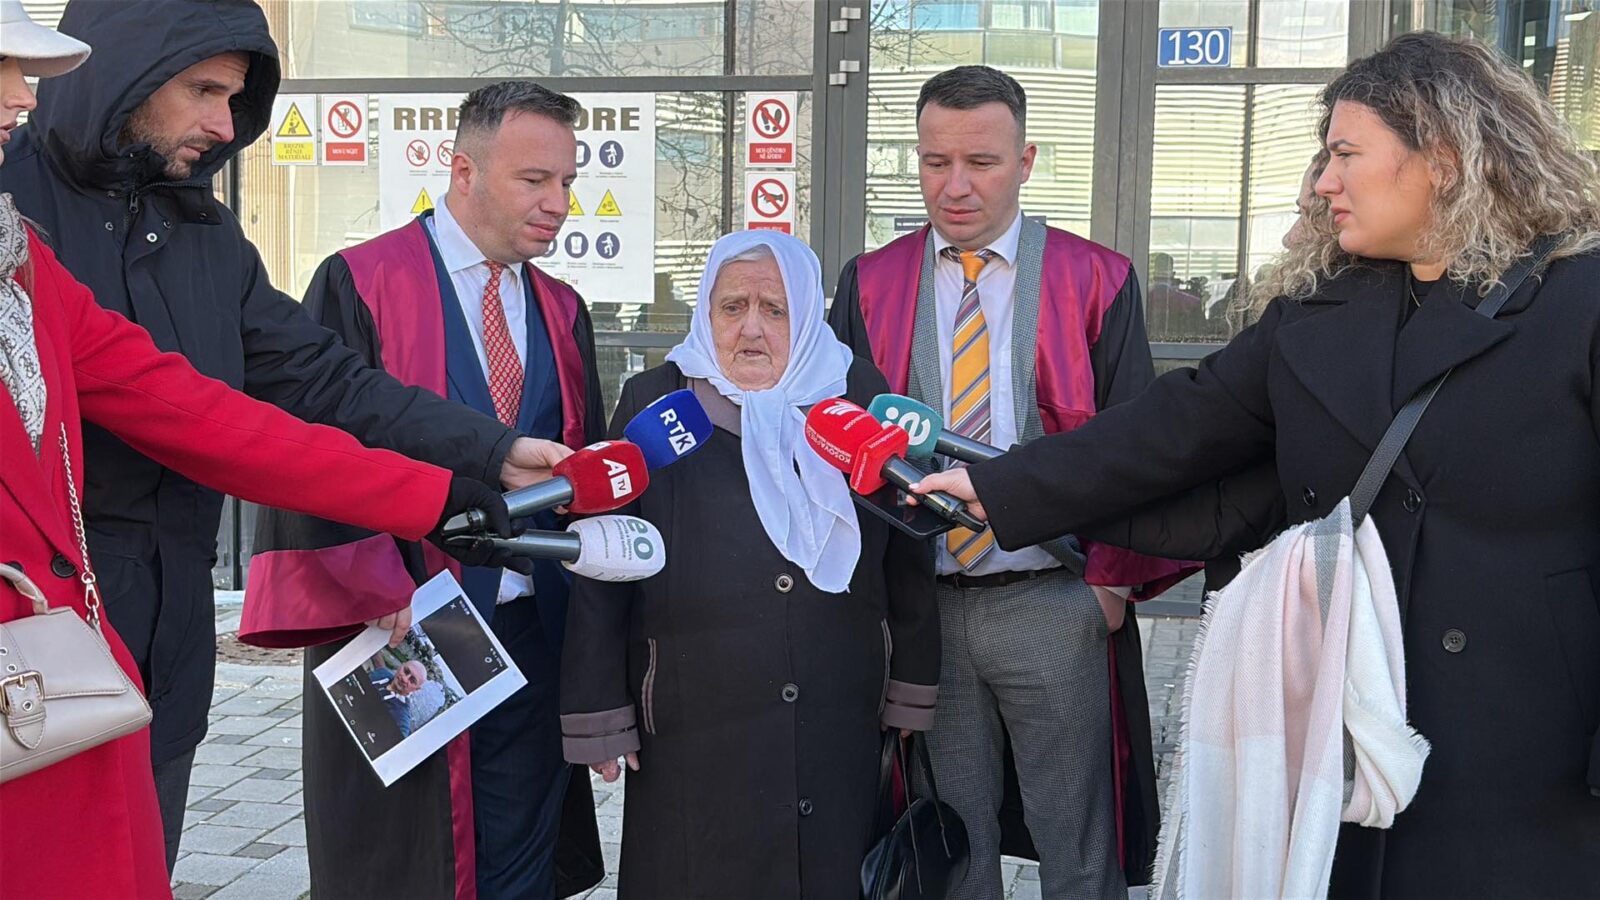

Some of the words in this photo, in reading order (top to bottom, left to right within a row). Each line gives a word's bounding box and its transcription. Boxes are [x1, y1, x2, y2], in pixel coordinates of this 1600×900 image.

[1168, 30, 1224, 65] 130
[660, 408, 692, 450] RTK
[626, 518, 654, 560] eo
